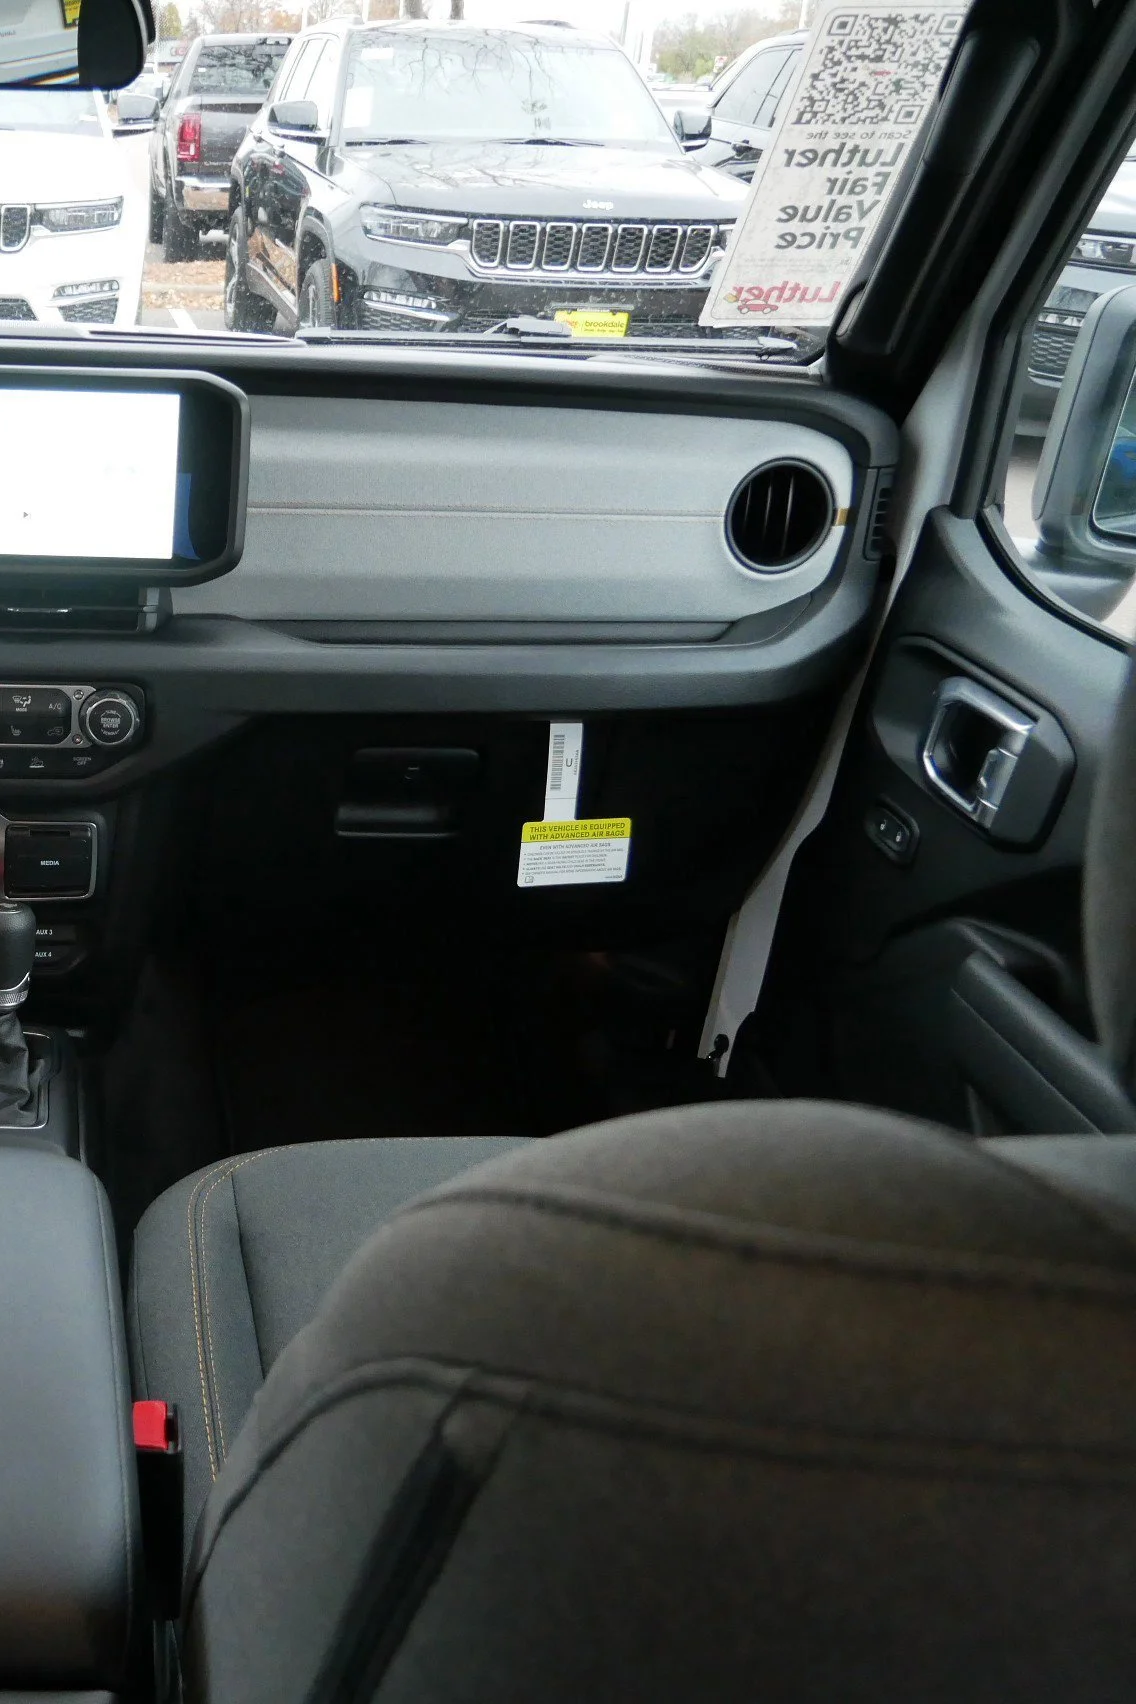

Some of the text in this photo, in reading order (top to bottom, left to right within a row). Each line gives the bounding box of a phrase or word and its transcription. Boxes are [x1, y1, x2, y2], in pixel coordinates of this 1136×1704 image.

[583, 200, 614, 210] Jeep
[584, 320, 624, 328] brookdale
[48, 702, 62, 711] A/C
[530, 825, 547, 834] THIS
[548, 823, 579, 833] VEHICLE
[589, 822, 626, 831] EQUIPPED
[529, 833, 548, 841] WITH
[549, 832, 590, 840] ADVANCED
[565, 842, 590, 850] ADVANCED
